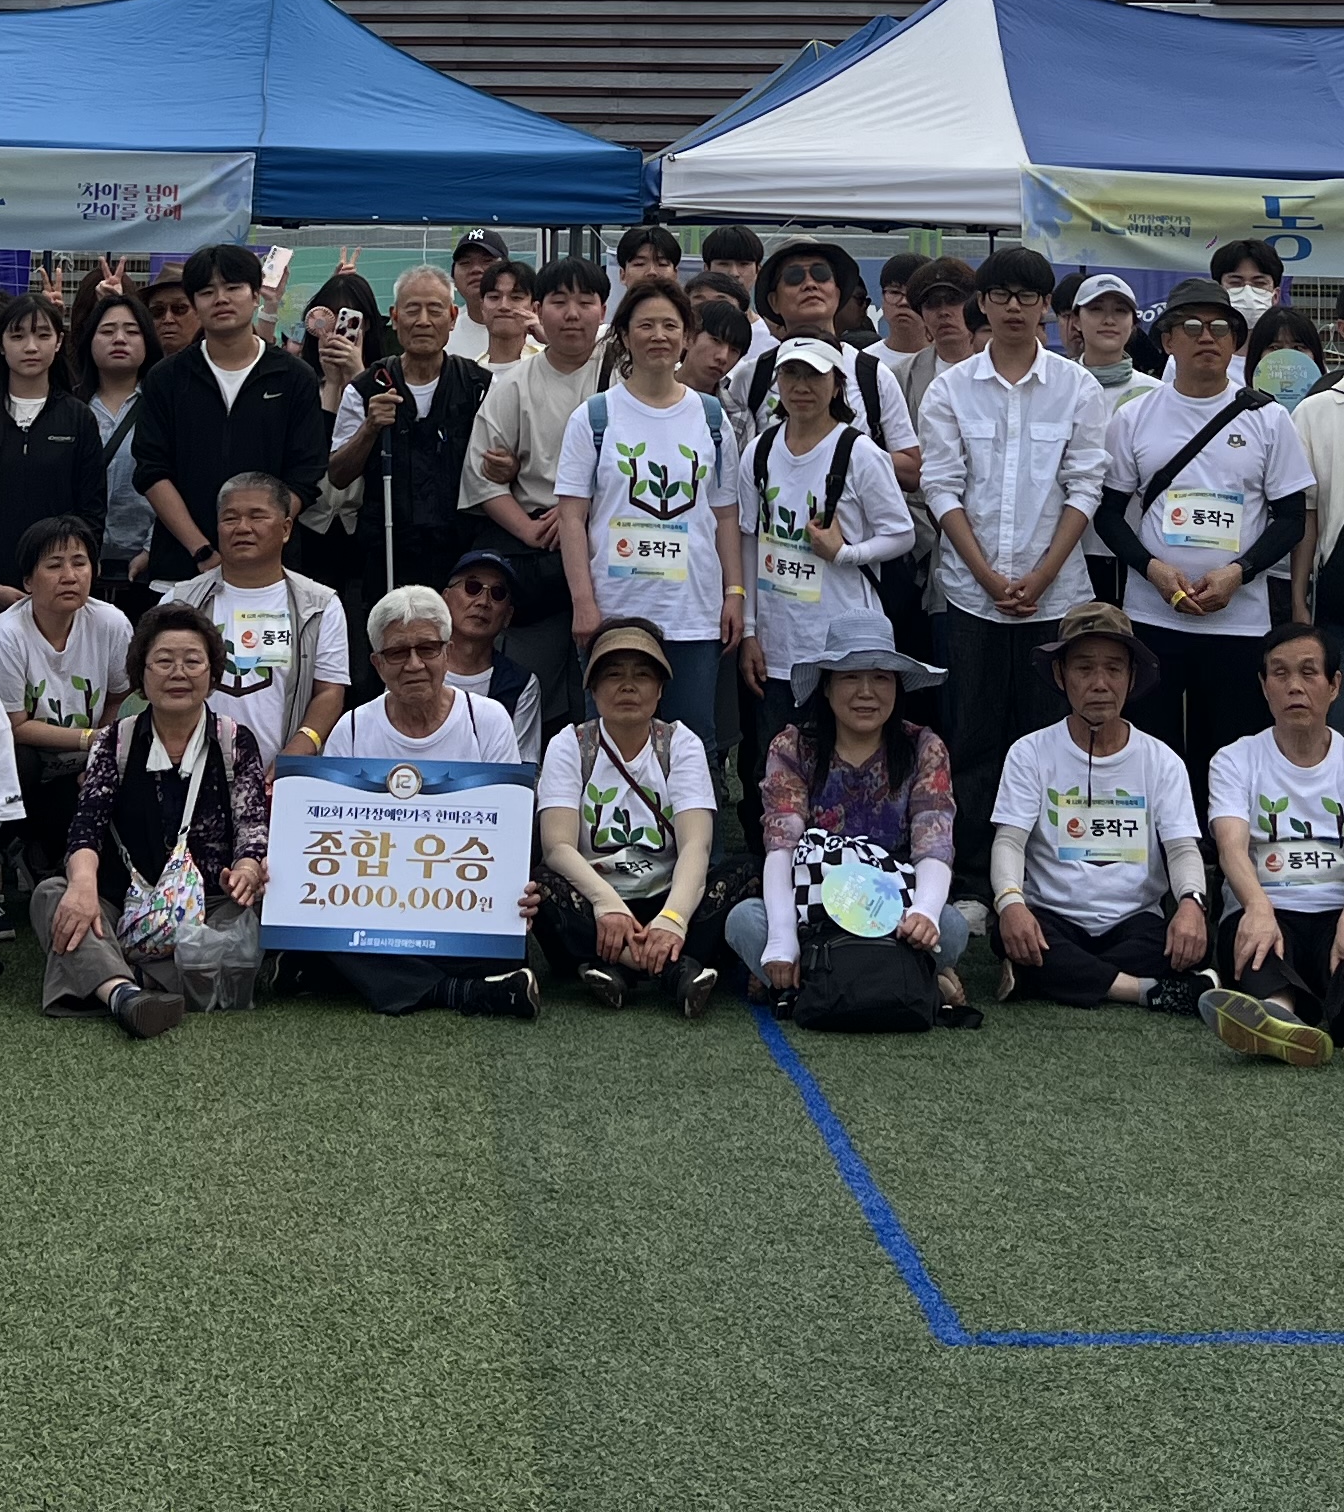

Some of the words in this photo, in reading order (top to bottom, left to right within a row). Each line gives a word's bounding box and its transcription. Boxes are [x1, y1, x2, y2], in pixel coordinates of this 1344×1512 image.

[145, 183, 179, 203] 넘어
[1191, 509, 1235, 528] 동작구
[637, 540, 682, 558] 동작구
[777, 558, 816, 580] 동작구
[261, 630, 292, 646] 동작
[306, 805, 343, 820] 제12회
[346, 806, 432, 823] 시각장애인가족
[436, 810, 498, 825] 한마음축제
[1090, 818, 1139, 838] 동작구
[303, 829, 397, 878] 종합
[406, 833, 495, 882] 우승
[1287, 850, 1337, 869] 동작구
